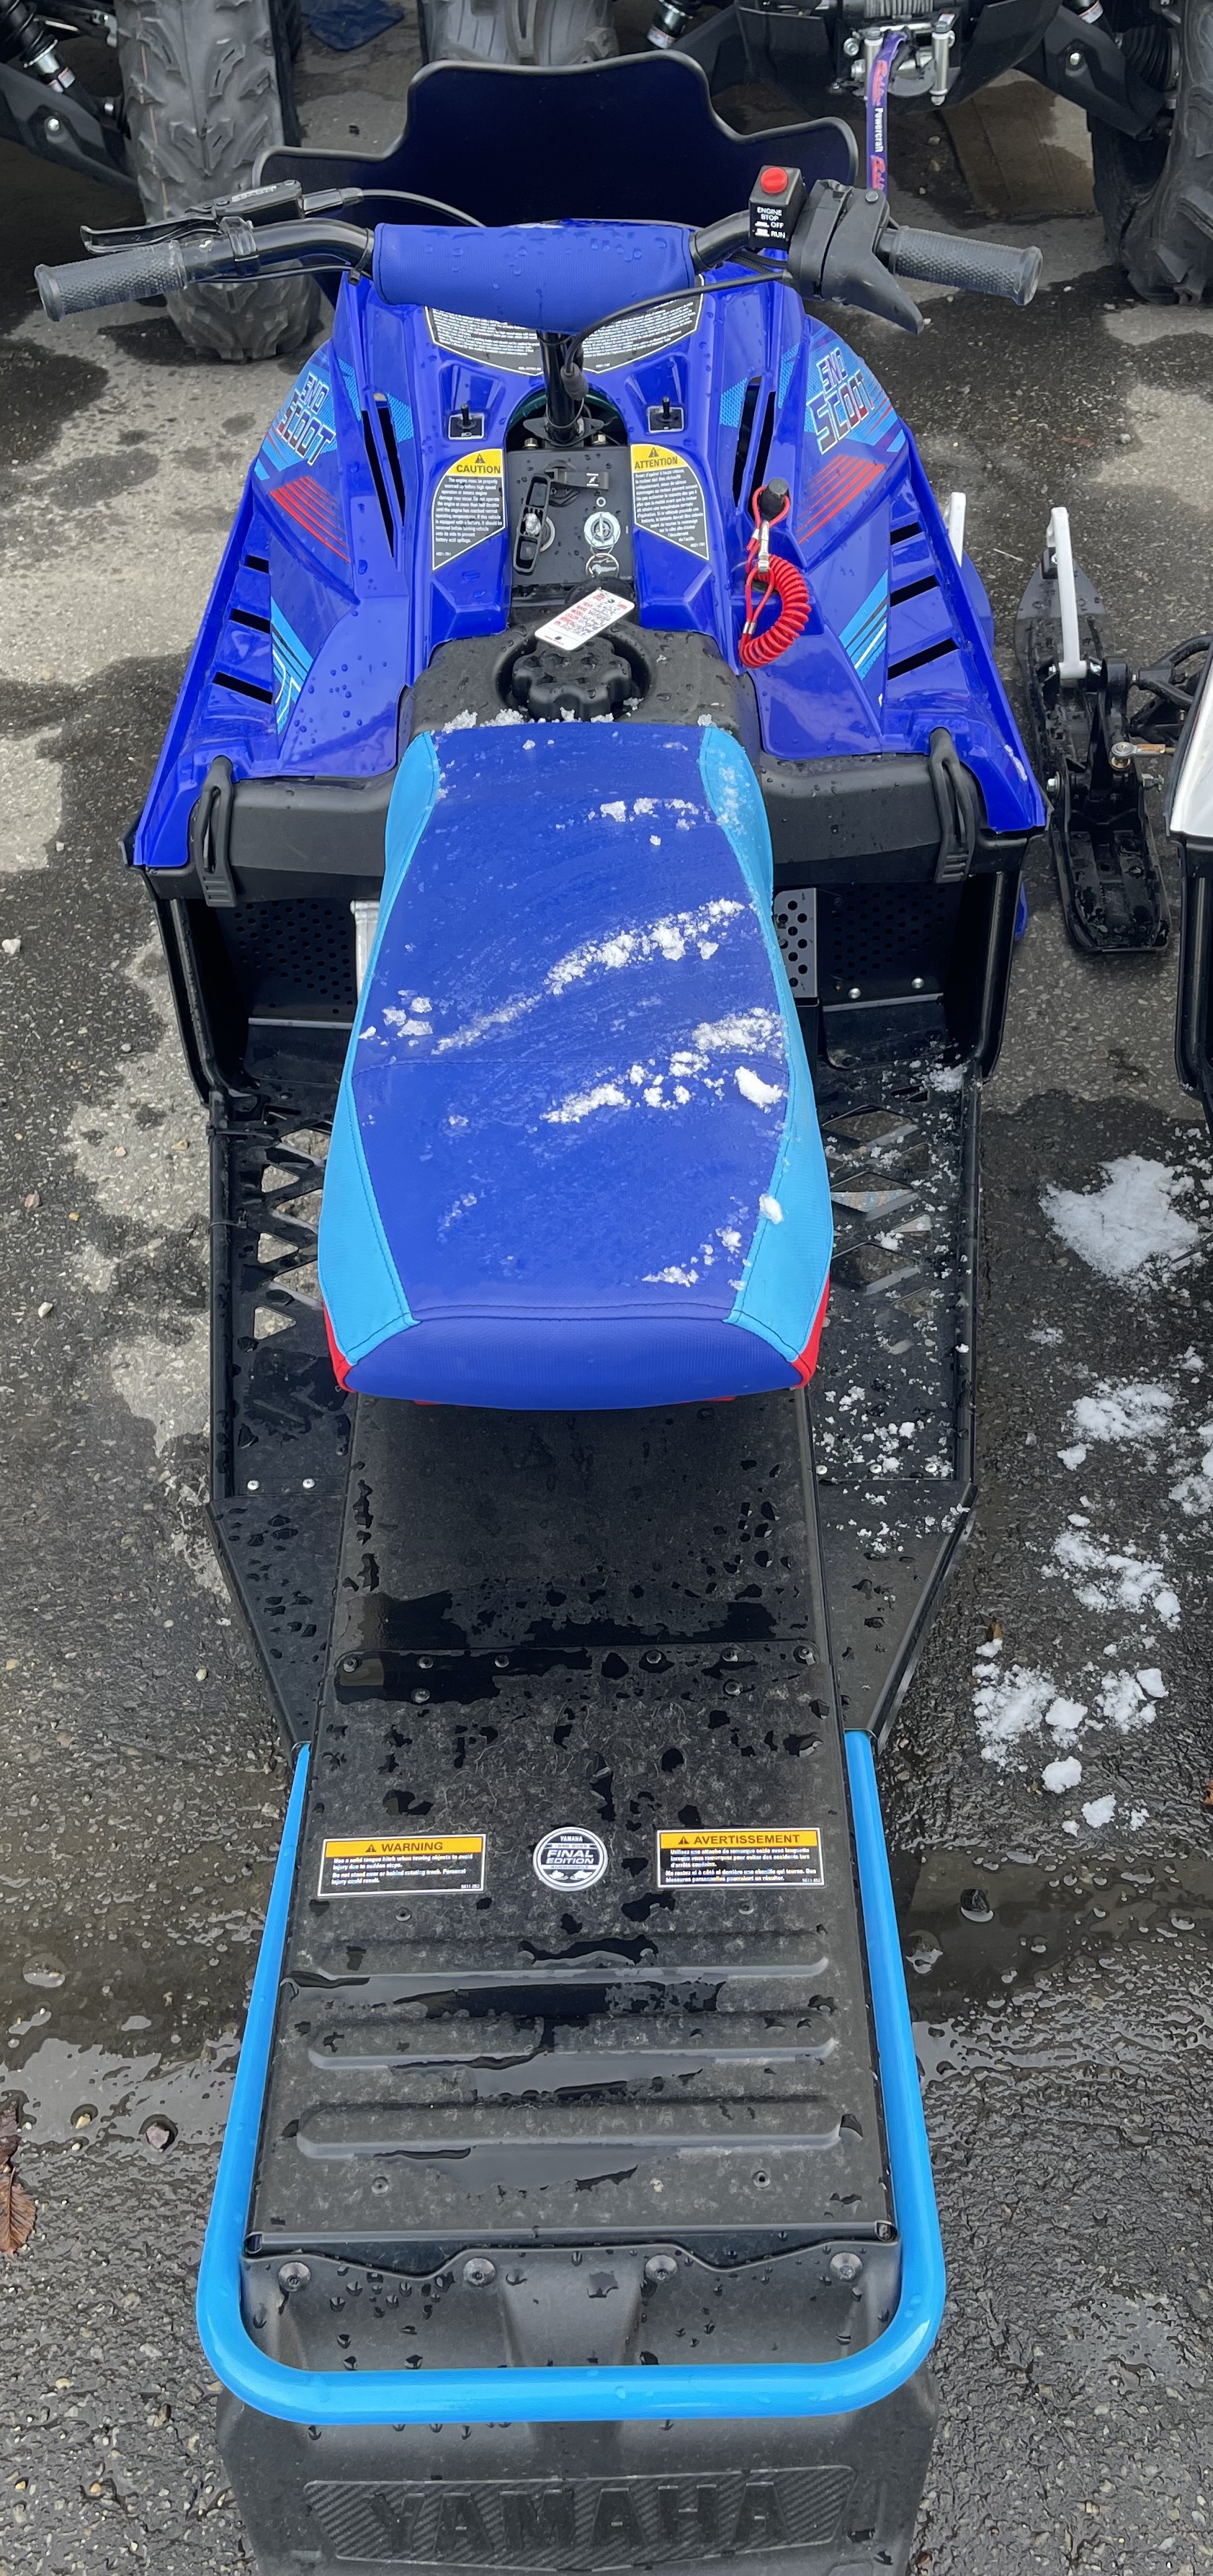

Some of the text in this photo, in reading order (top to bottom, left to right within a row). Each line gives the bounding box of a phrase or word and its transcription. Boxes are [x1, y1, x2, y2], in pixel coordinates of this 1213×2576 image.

[874, 107, 884, 153] Powercraft
[757, 207, 782, 216] ENGINE
[816, 347, 848, 394] SNO
[300, 372, 330, 415] SNO
[806, 369, 874, 455] SCOOT
[277, 388, 336, 465] SCOOT
[457, 465, 501, 473] CAUTION
[635, 455, 677, 469] ATTENTION
[381, 1842, 443, 1852] WARNING
[694, 1835, 800, 1844] AVERTISSEMENT
[367, 2482, 791, 2553] YAMAHA
